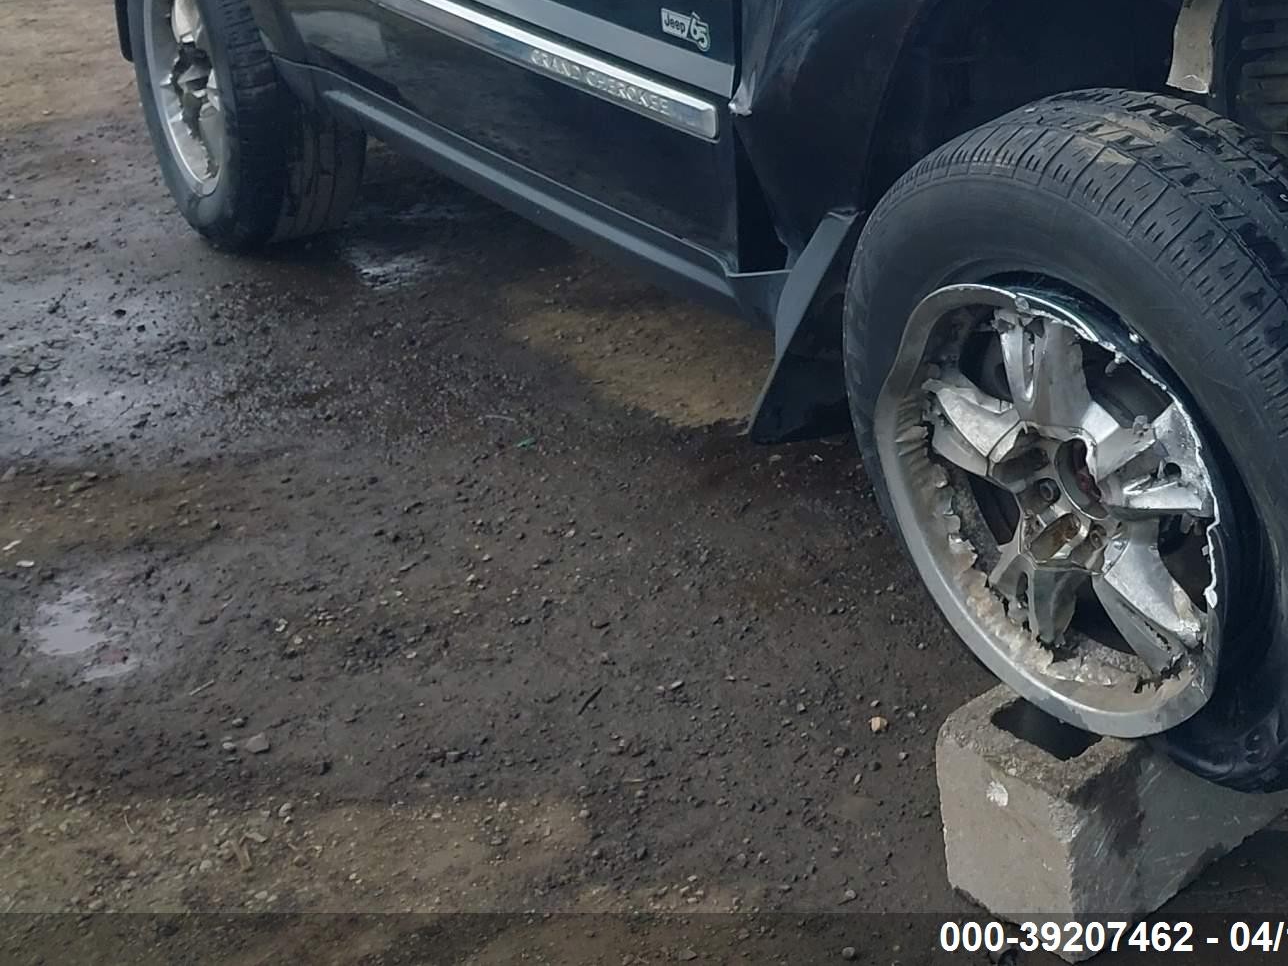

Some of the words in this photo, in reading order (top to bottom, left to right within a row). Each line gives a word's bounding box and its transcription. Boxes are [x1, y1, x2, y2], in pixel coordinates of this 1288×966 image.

[664, 12, 686, 34] Jeep
[690, 13, 710, 50] 65
[530, 48, 582, 81] GRAND
[584, 70, 671, 115] CHEROKEE
